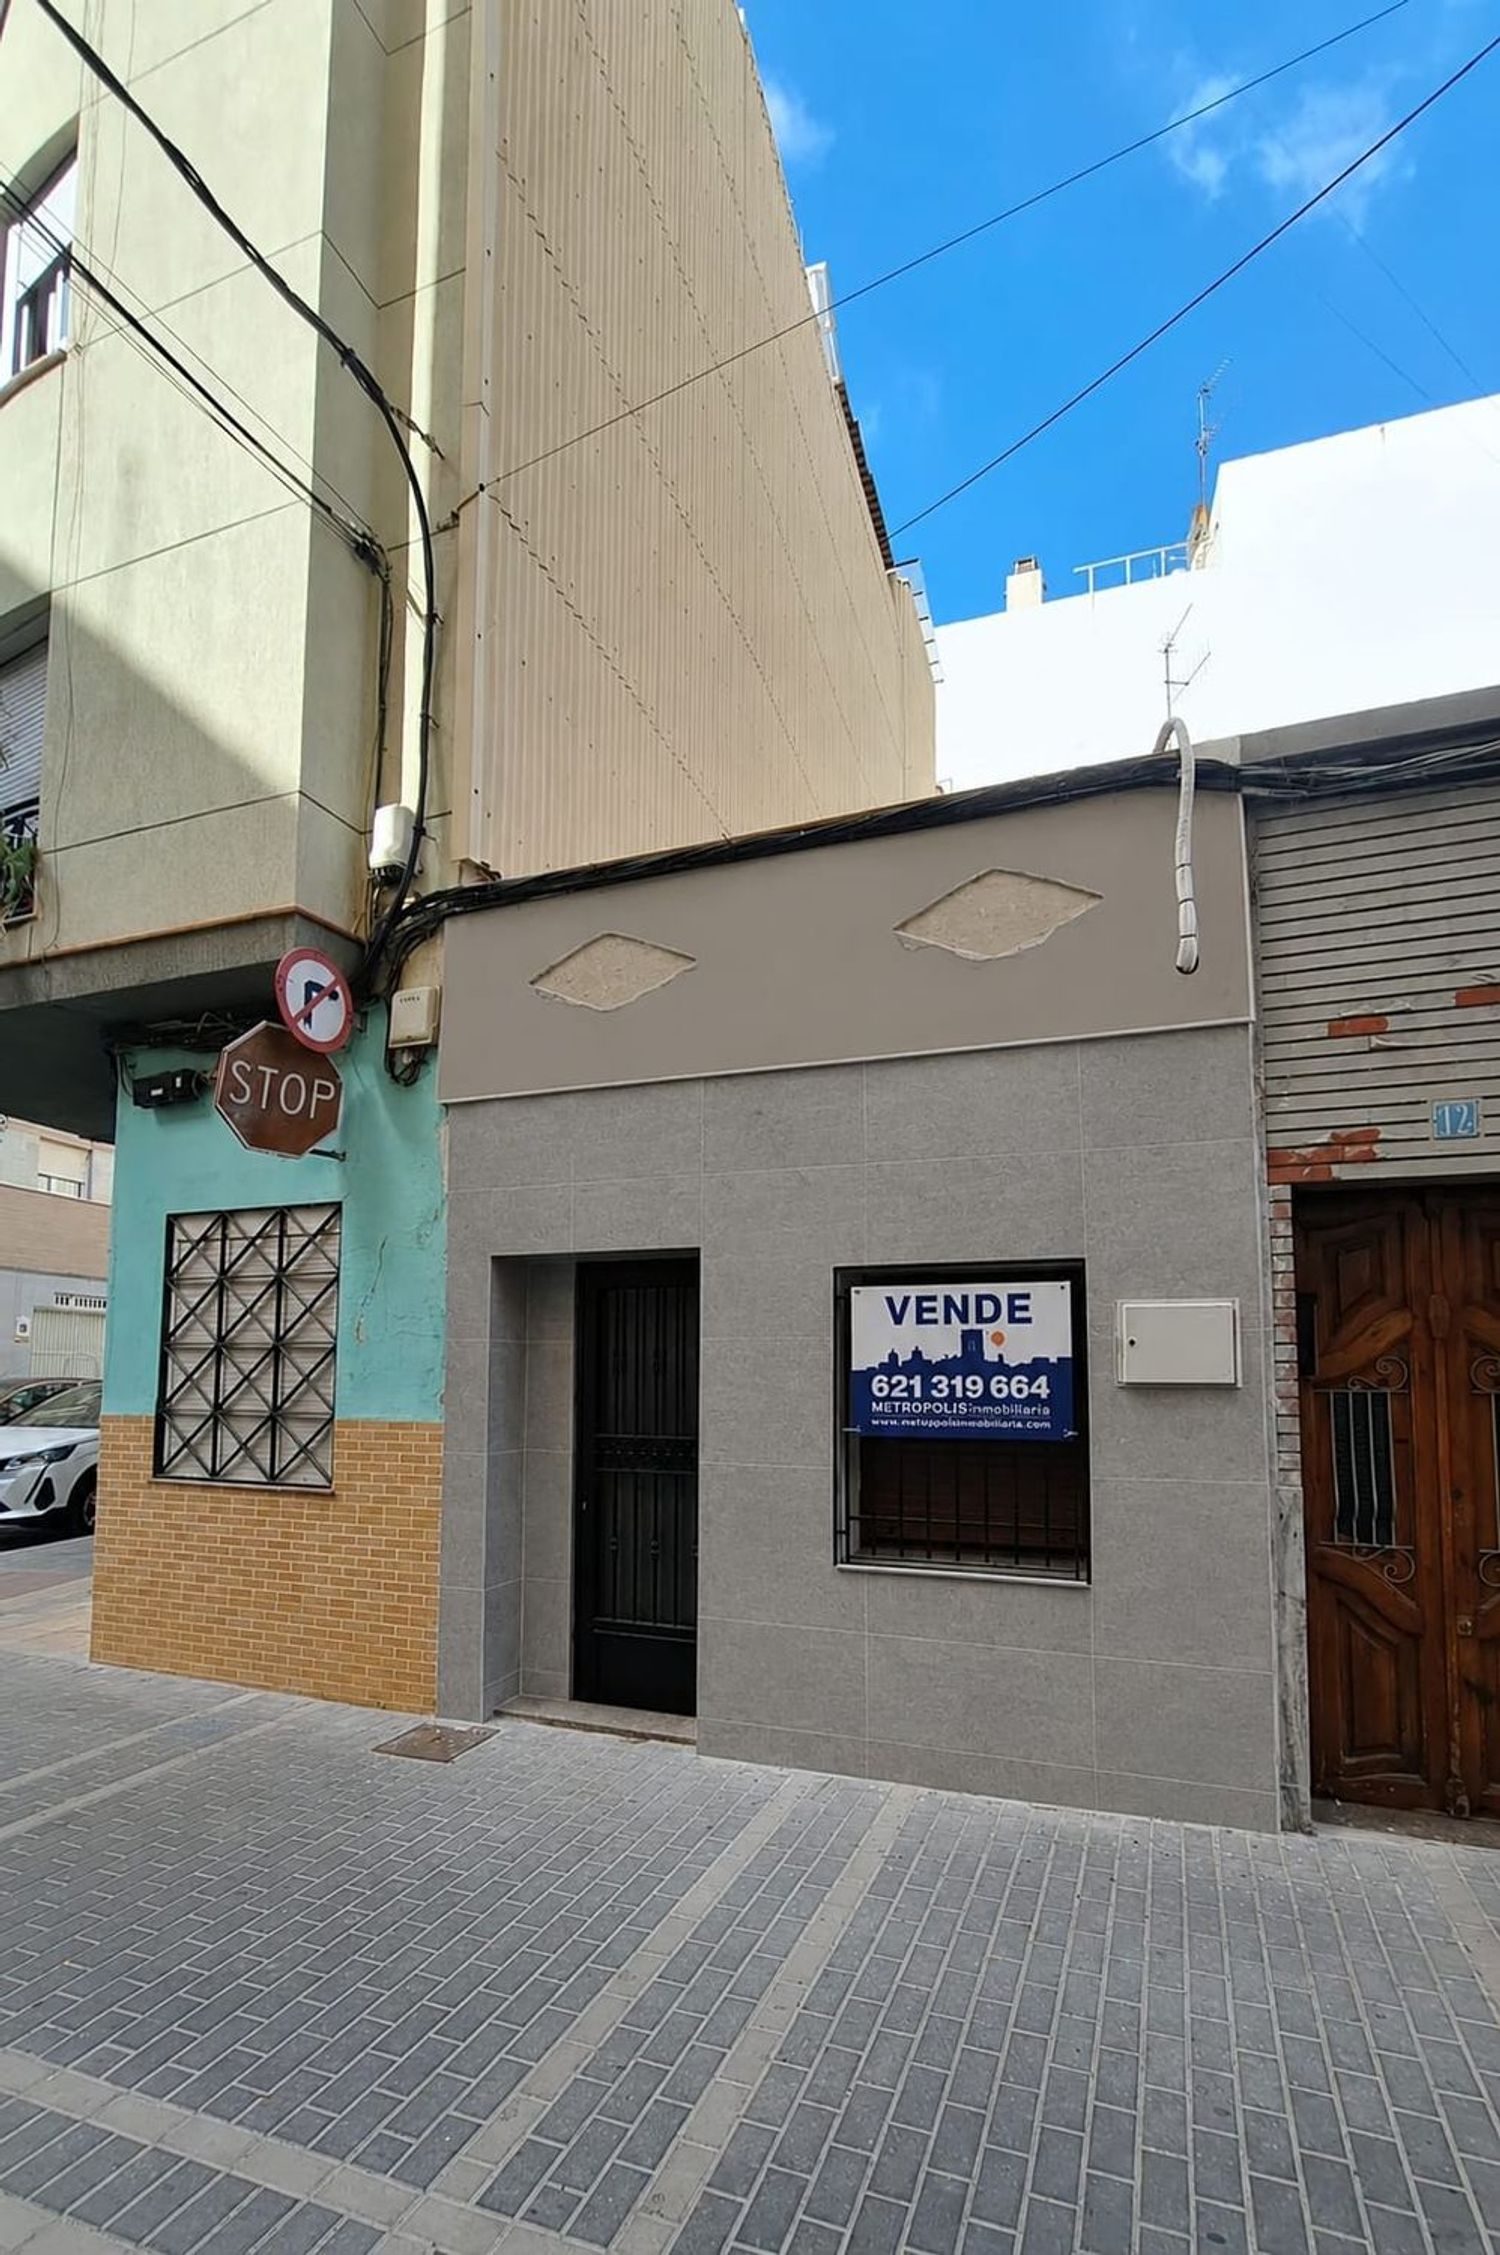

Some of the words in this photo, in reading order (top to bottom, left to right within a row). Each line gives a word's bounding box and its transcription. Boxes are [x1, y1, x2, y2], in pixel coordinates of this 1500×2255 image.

[229, 1060, 336, 1119] STOP
[1438, 1104, 1473, 1135] 12
[885, 1292, 1033, 1325] VENDE
[871, 1374, 922, 1398] 621
[930, 1375, 984, 1398] 319
[989, 1375, 1051, 1399] 664
